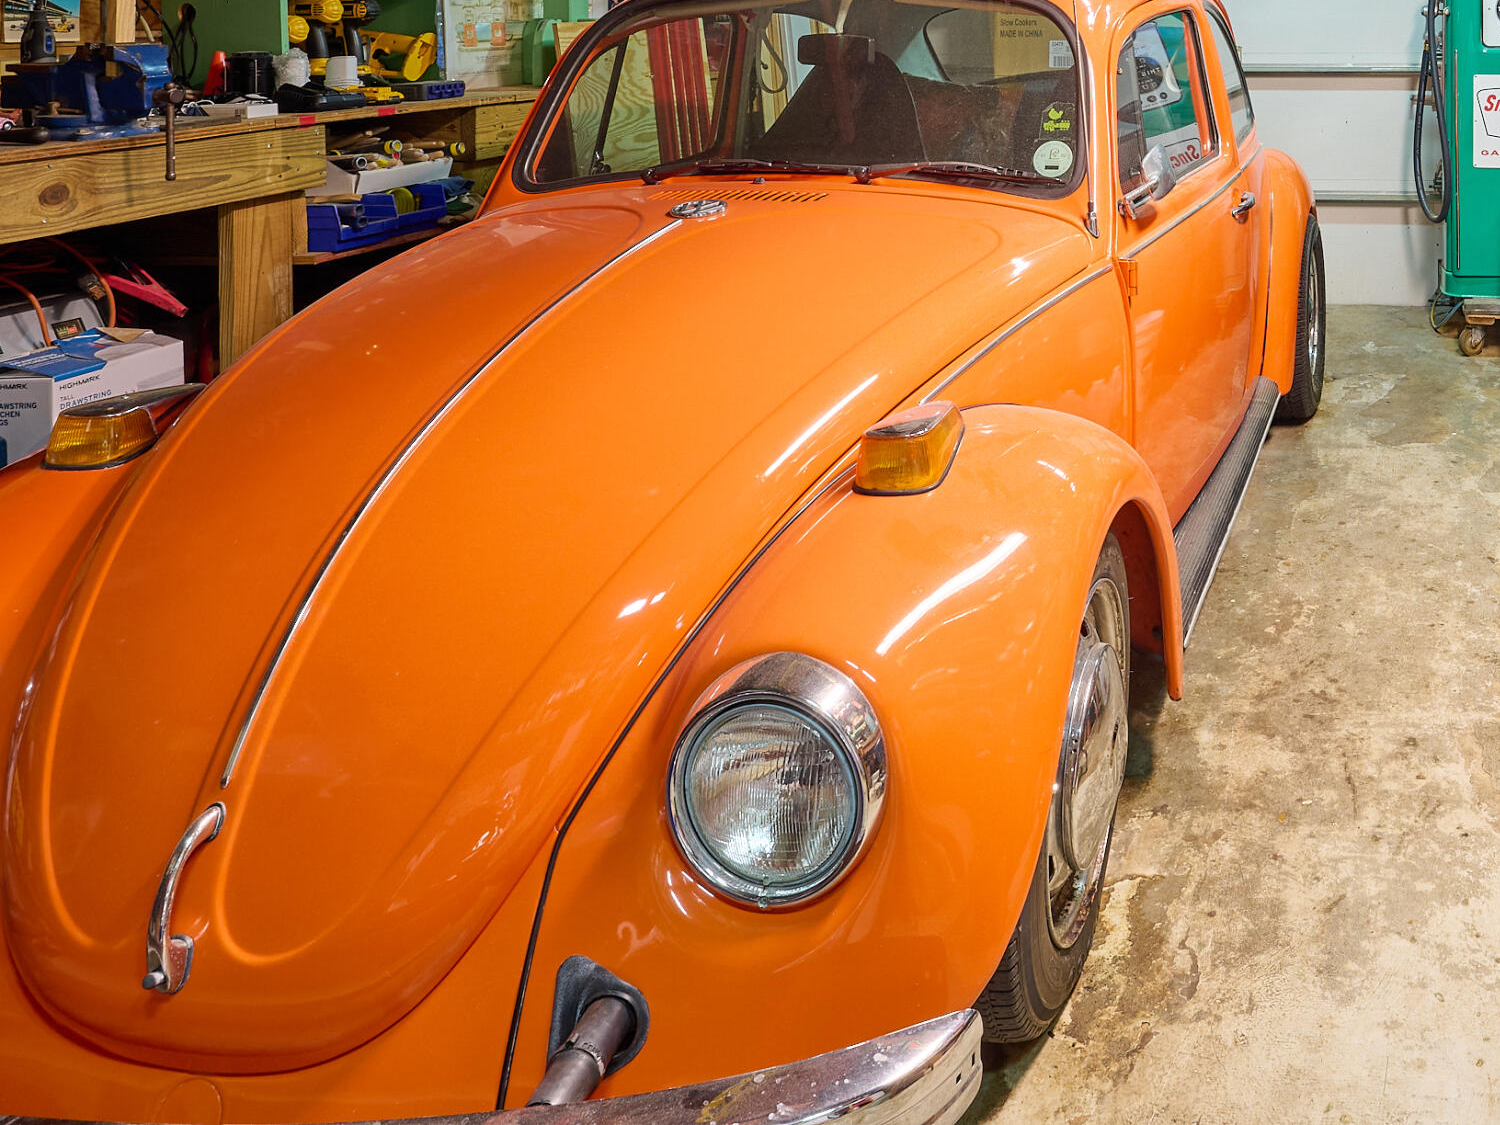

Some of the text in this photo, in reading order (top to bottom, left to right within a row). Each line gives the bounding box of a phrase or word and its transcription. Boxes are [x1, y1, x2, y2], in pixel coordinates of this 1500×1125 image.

[1000, 18, 1037, 26] Slow Cookers
[1000, 29, 1043, 38] MADE IN CHINA
[59, 375, 101, 391] HIGHMARK
[60, 390, 112, 410] DRAWSTRING
